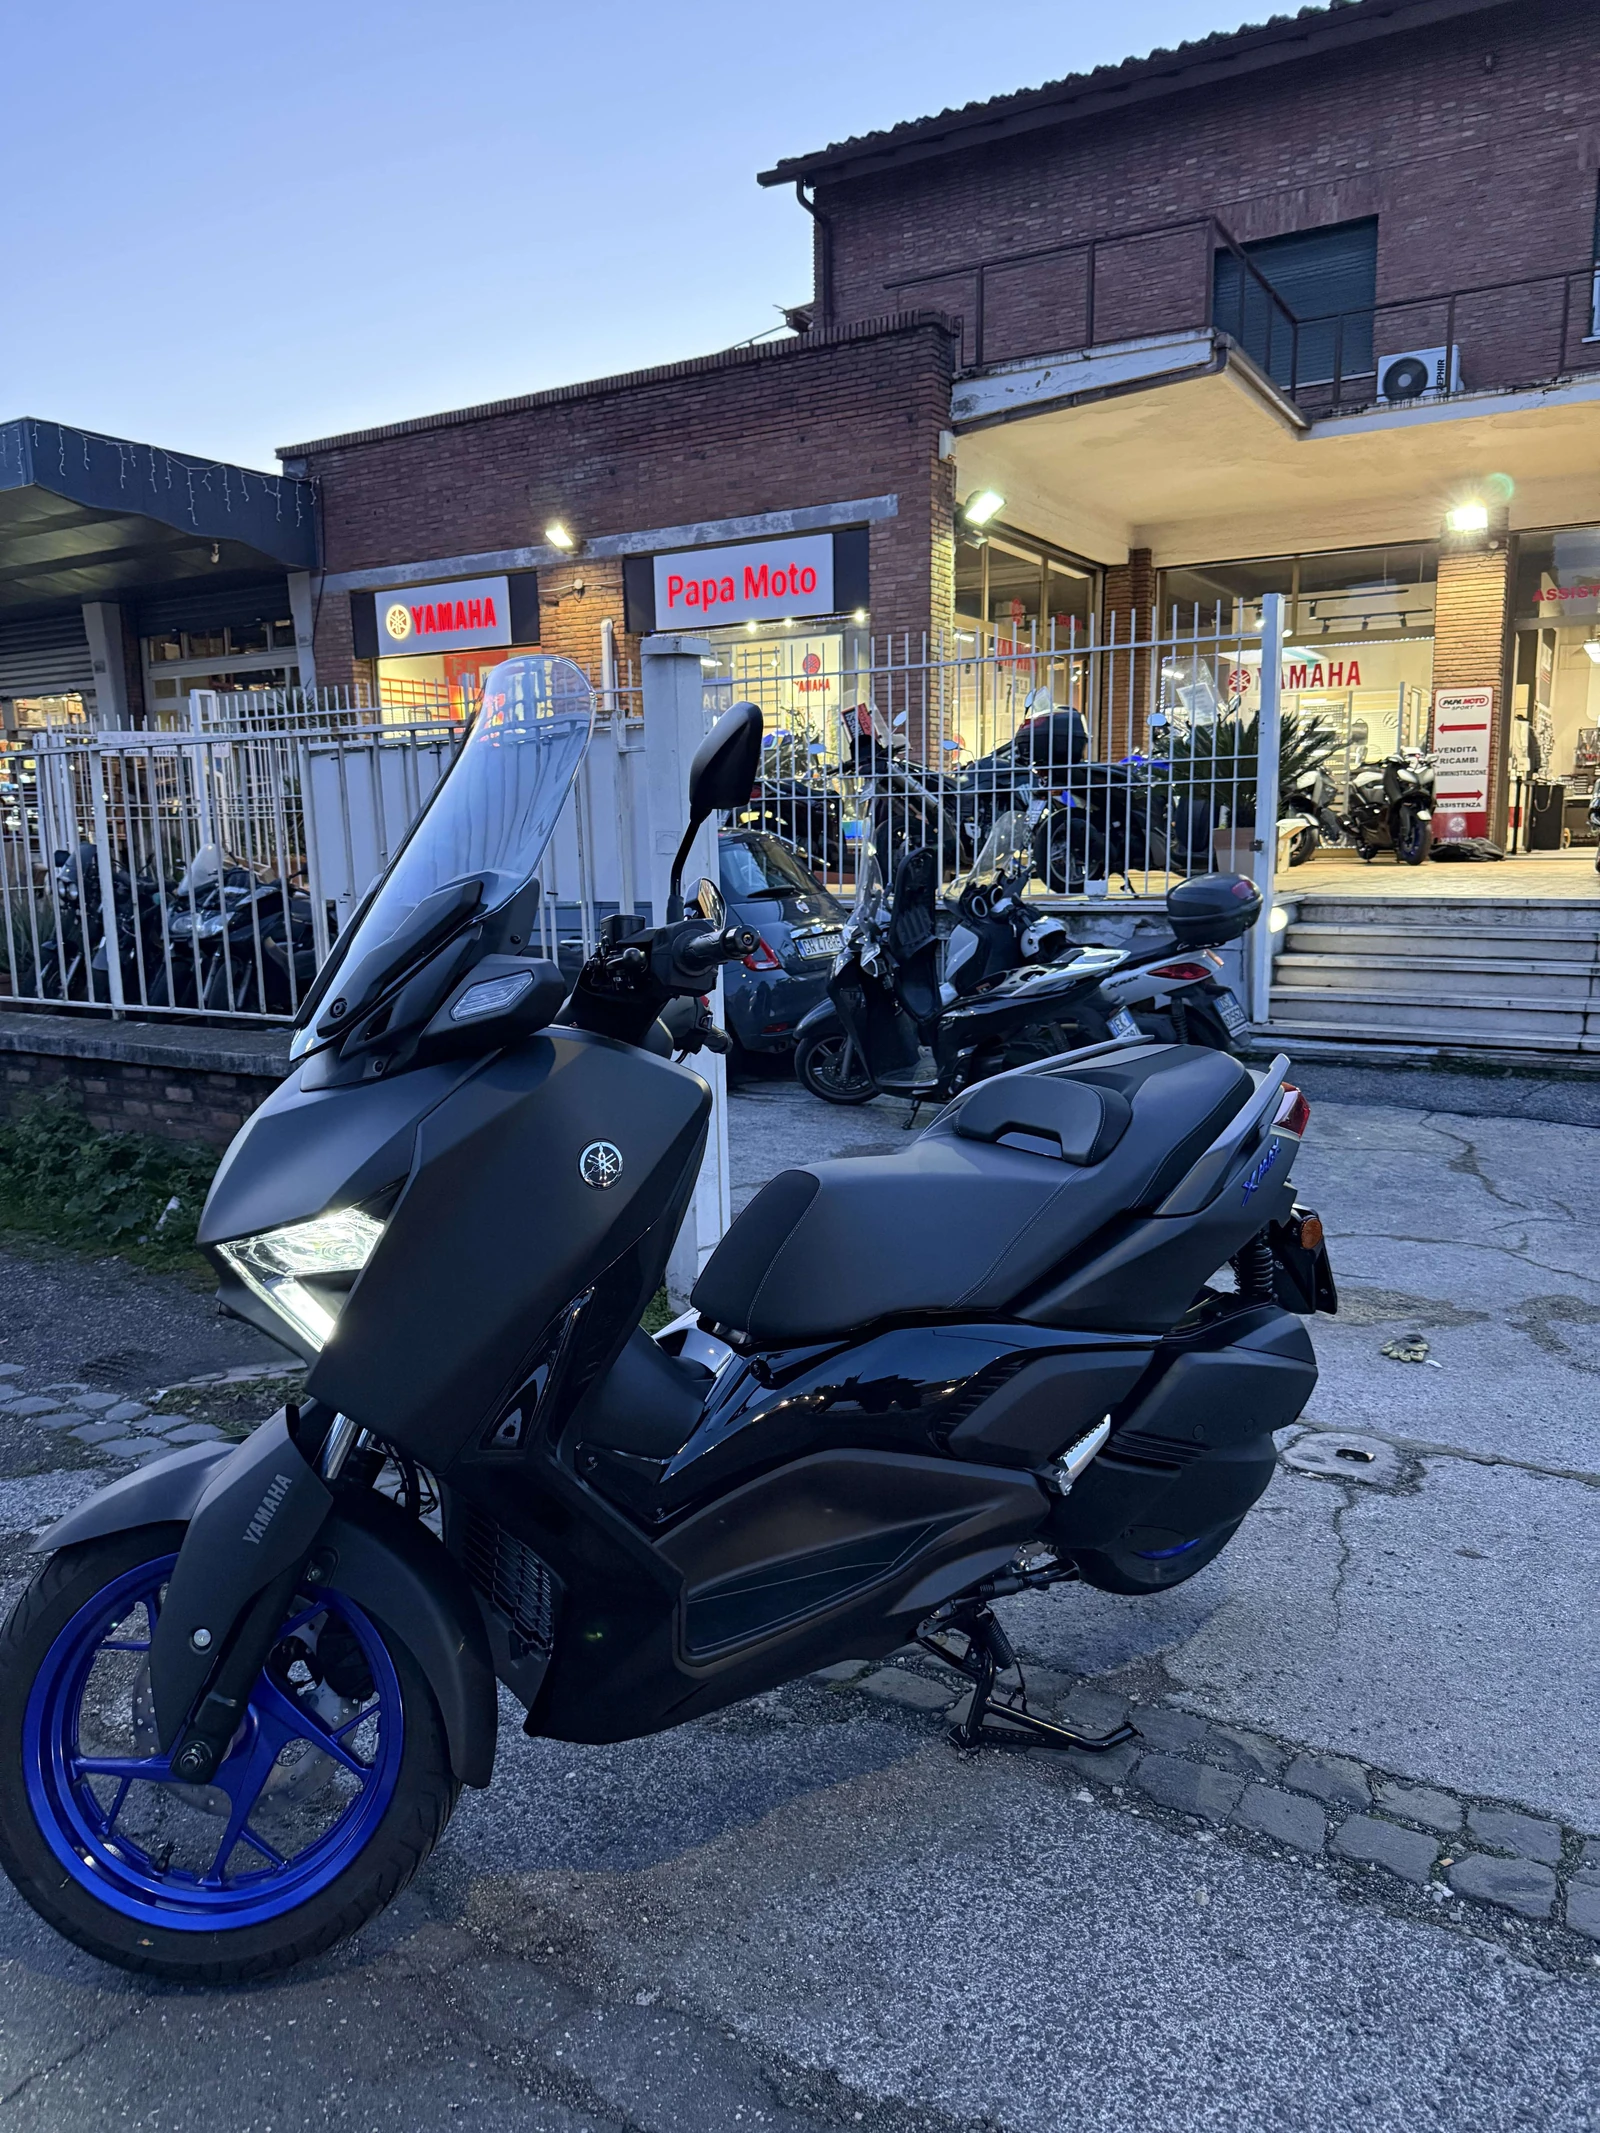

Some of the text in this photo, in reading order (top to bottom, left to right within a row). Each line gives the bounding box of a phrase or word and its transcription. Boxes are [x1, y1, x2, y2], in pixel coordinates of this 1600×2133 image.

[667, 561, 817, 613] Papa Moto
[410, 596, 498, 636] YAMAHA
[1257, 660, 1362, 691] MAHA
[1463, 697, 1486, 705] MOTO
[1437, 746, 1478, 754] VENDITA
[1439, 757, 1479, 765] RICAMBI
[242, 1473, 293, 1545] YAMAHA
